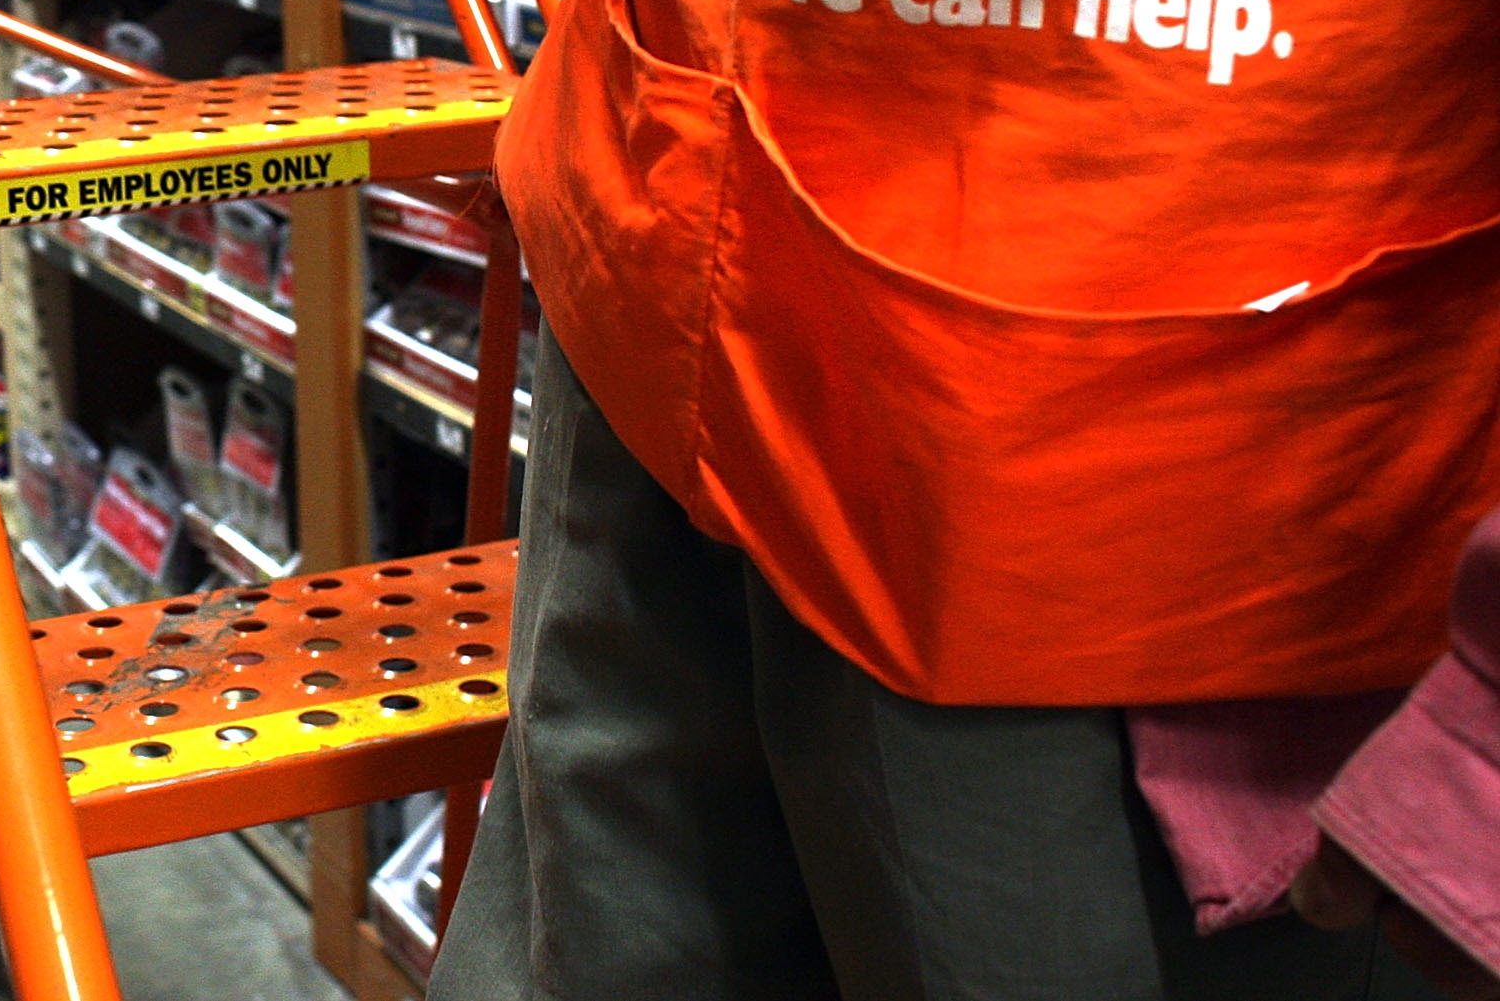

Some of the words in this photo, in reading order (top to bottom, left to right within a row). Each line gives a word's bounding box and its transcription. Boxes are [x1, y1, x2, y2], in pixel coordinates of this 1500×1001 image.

[8, 184, 68, 213] FOR
[78, 164, 253, 207] EMPLOYEES
[263, 152, 333, 184] ONLY
